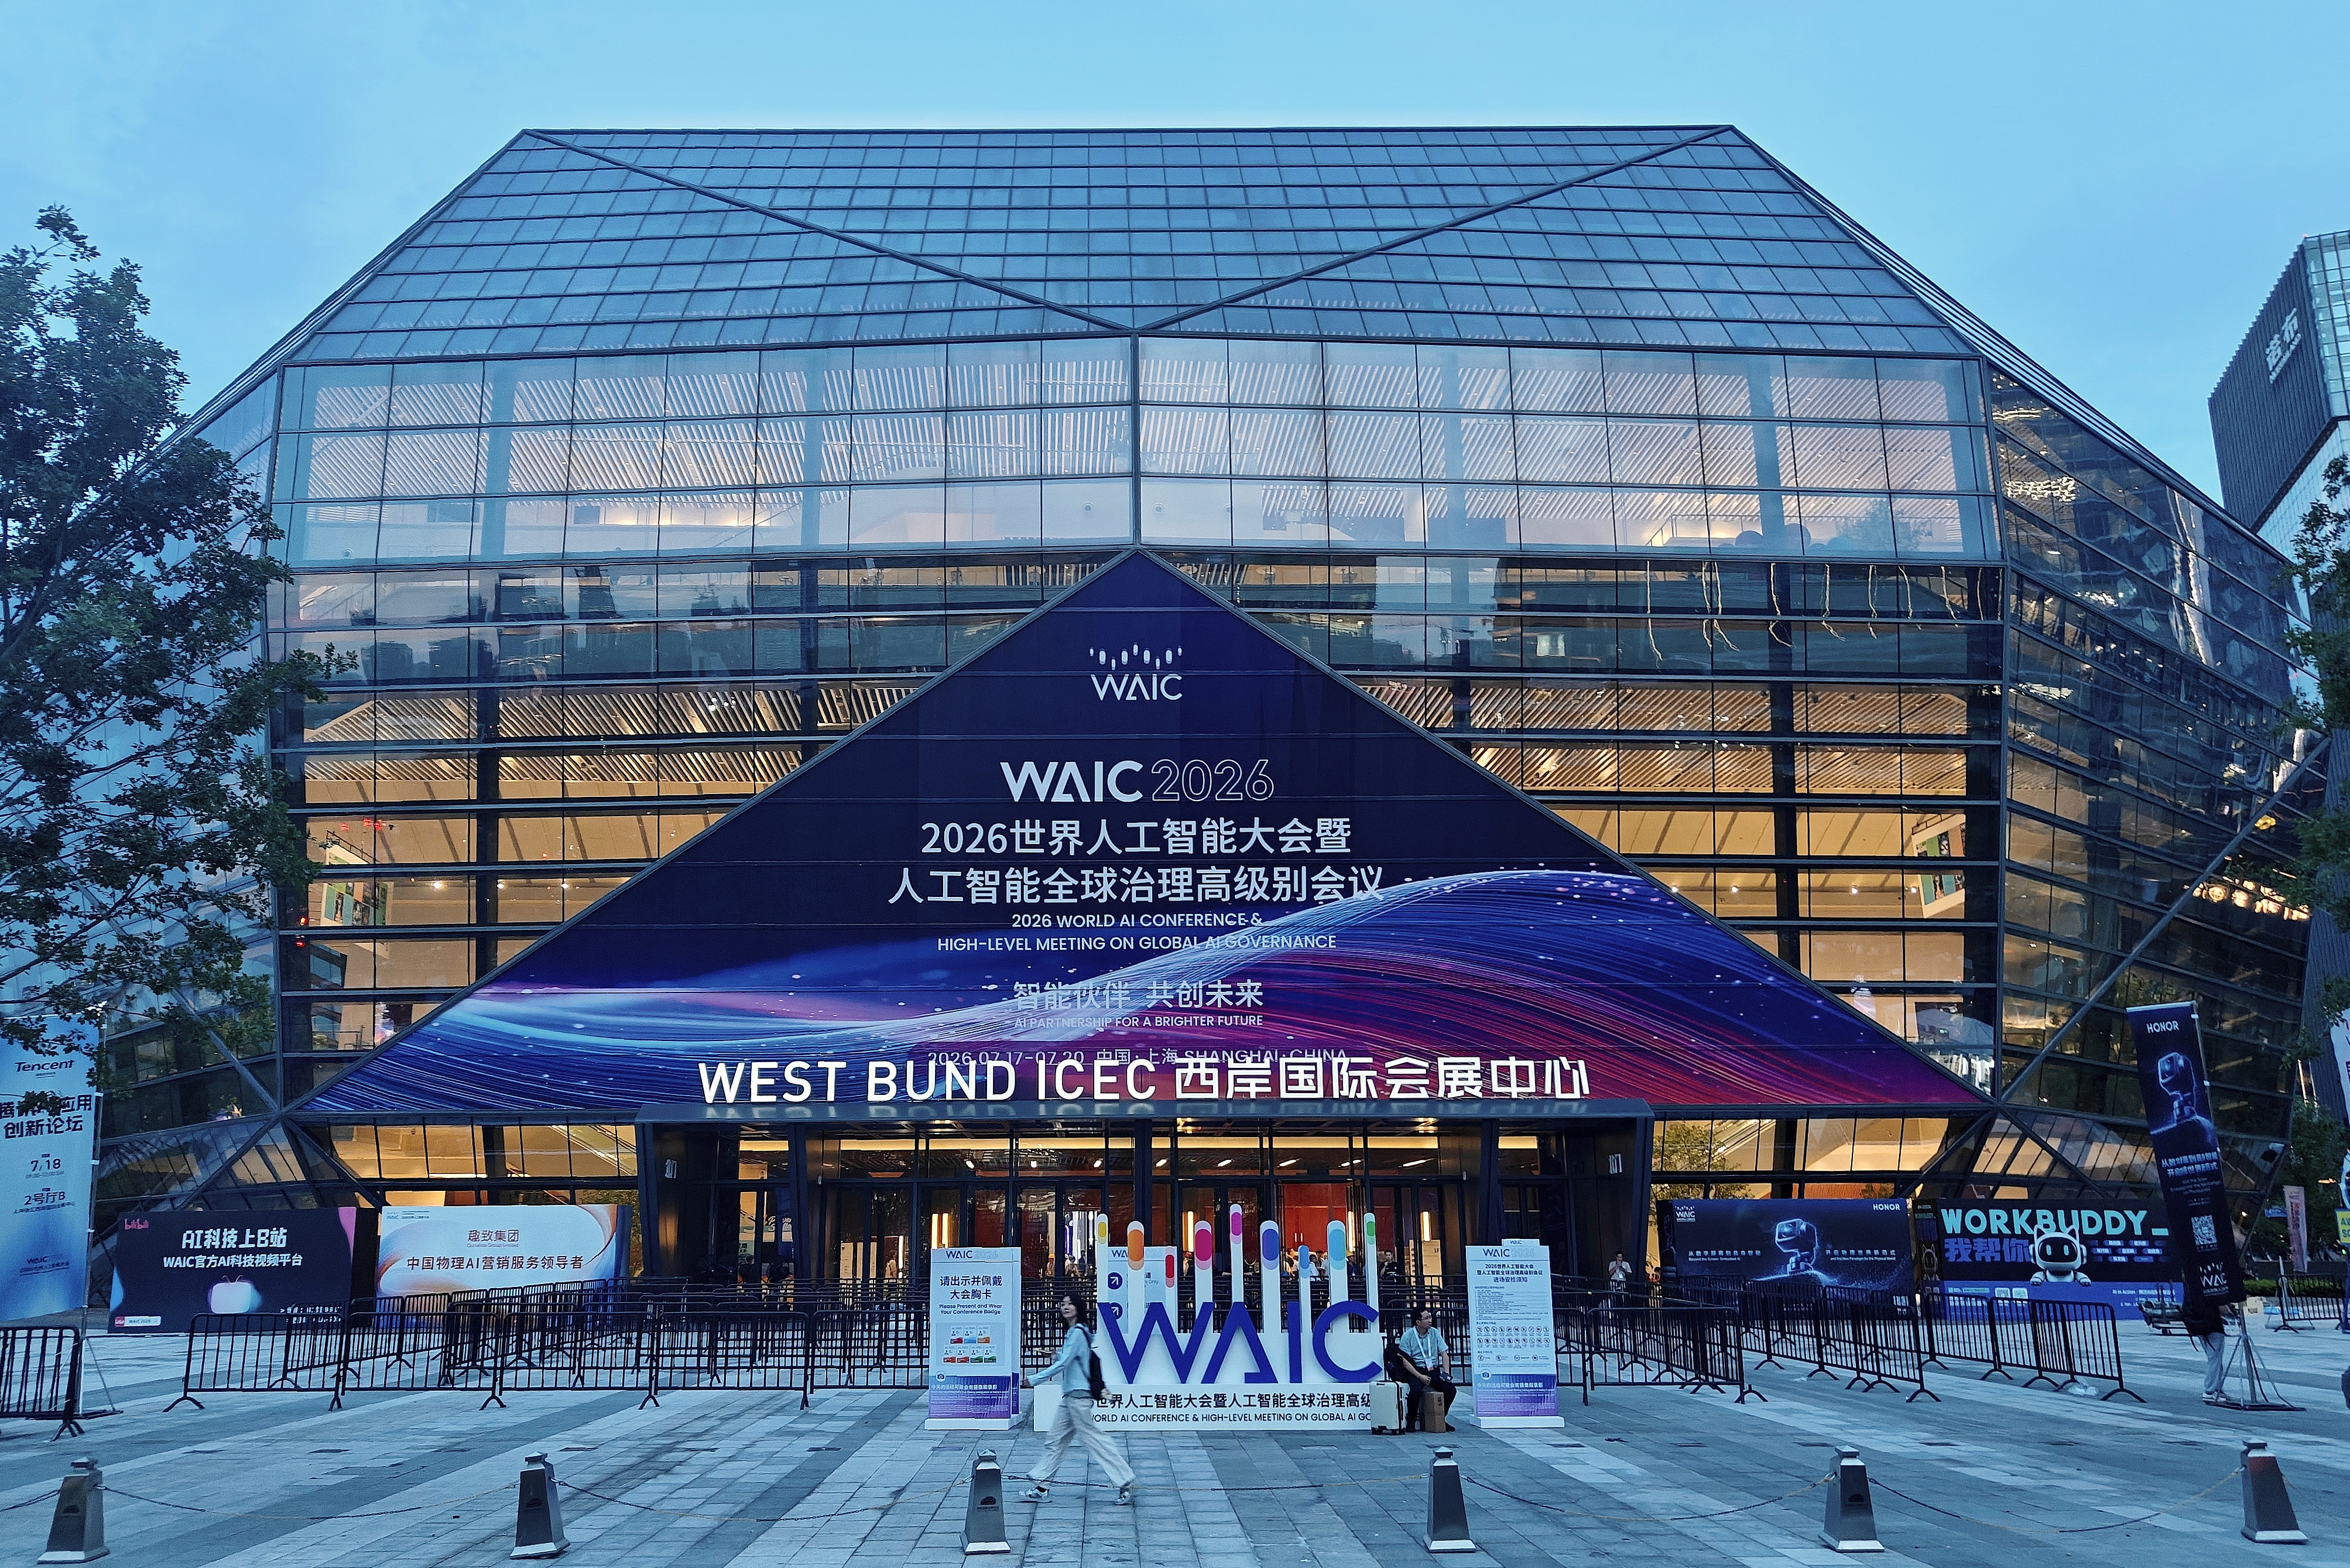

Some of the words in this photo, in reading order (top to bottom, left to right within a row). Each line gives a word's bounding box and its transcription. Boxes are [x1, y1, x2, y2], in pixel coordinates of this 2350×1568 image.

[1091, 675, 1182, 700] WAIC
[1000, 761, 1143, 802] WAIC
[1151, 759, 1274, 802] 2026
[921, 818, 1351, 855] 2026世界人工智能大会暨
[888, 865, 1383, 904] 人工智能全球治理高级别会议
[1012, 915, 1051, 927] 2026
[1057, 915, 1115, 927] WORLD
[1120, 914, 1135, 927] AI
[1140, 913, 1246, 926] CONFERENCE
[1251, 913, 1263, 925] &
[938, 938, 1032, 951] HIGH-LEVEL
[1036, 937, 1106, 951] MEETING
[1110, 937, 1134, 950] ON
[1139, 937, 1201, 950] GLOBAL
[1205, 936, 1221, 949] AI
[1225, 935, 1337, 949] GOVERNANCE
[1013, 981, 1131, 1009] 智能伙伴
[1146, 980, 1263, 1008] 共创未来
[1014, 1016, 1026, 1028] AI
[1029, 1016, 1112, 1028] PARTNERSHIP
[1115, 1016, 1140, 1027] FOR
[1143, 1016, 1152, 1026] A
[1155, 1015, 1215, 1027] BRIGHTER
[1218, 1015, 1263, 1026] FUTURE
[2147, 1021, 2180, 1033] HONOR
[15, 1059, 75, 1072] Tencent
[698, 1061, 847, 1104] WEST
[867, 1060, 1016, 1102] BUND
[1037, 1059, 1157, 1100] ICEC
[1175, 1056, 1590, 1099] 西岸国际会展中心
[4, 1115, 83, 1139] 创新论坛
[24, 1192, 66, 1206] 2号厅B
[182, 1227, 287, 1249] AI科技上B站
[467, 1230, 519, 1242] 趣致集团
[946, 1250, 973, 1259] WAIC
[974, 1250, 998, 1259] 2026
[1483, 1248, 1510, 1257] WAIC
[1944, 1237, 2032, 1263] 我帮你
[163, 1253, 303, 1269] WAIC官方AI科技视频平台
[407, 1256, 584, 1270] 中国物理AI营销服务领导者
[940, 1275, 1002, 1286] 请出示并佩戴
[950, 1288, 992, 1299] 大会胸卡
[1097, 1300, 1383, 1384] WAIC
[1092, 1414, 1118, 1422] ORLD
[1202, 1413, 1252, 1422] HIGH-LEVEL
[1311, 1413, 1345, 1421] GLOBAL
